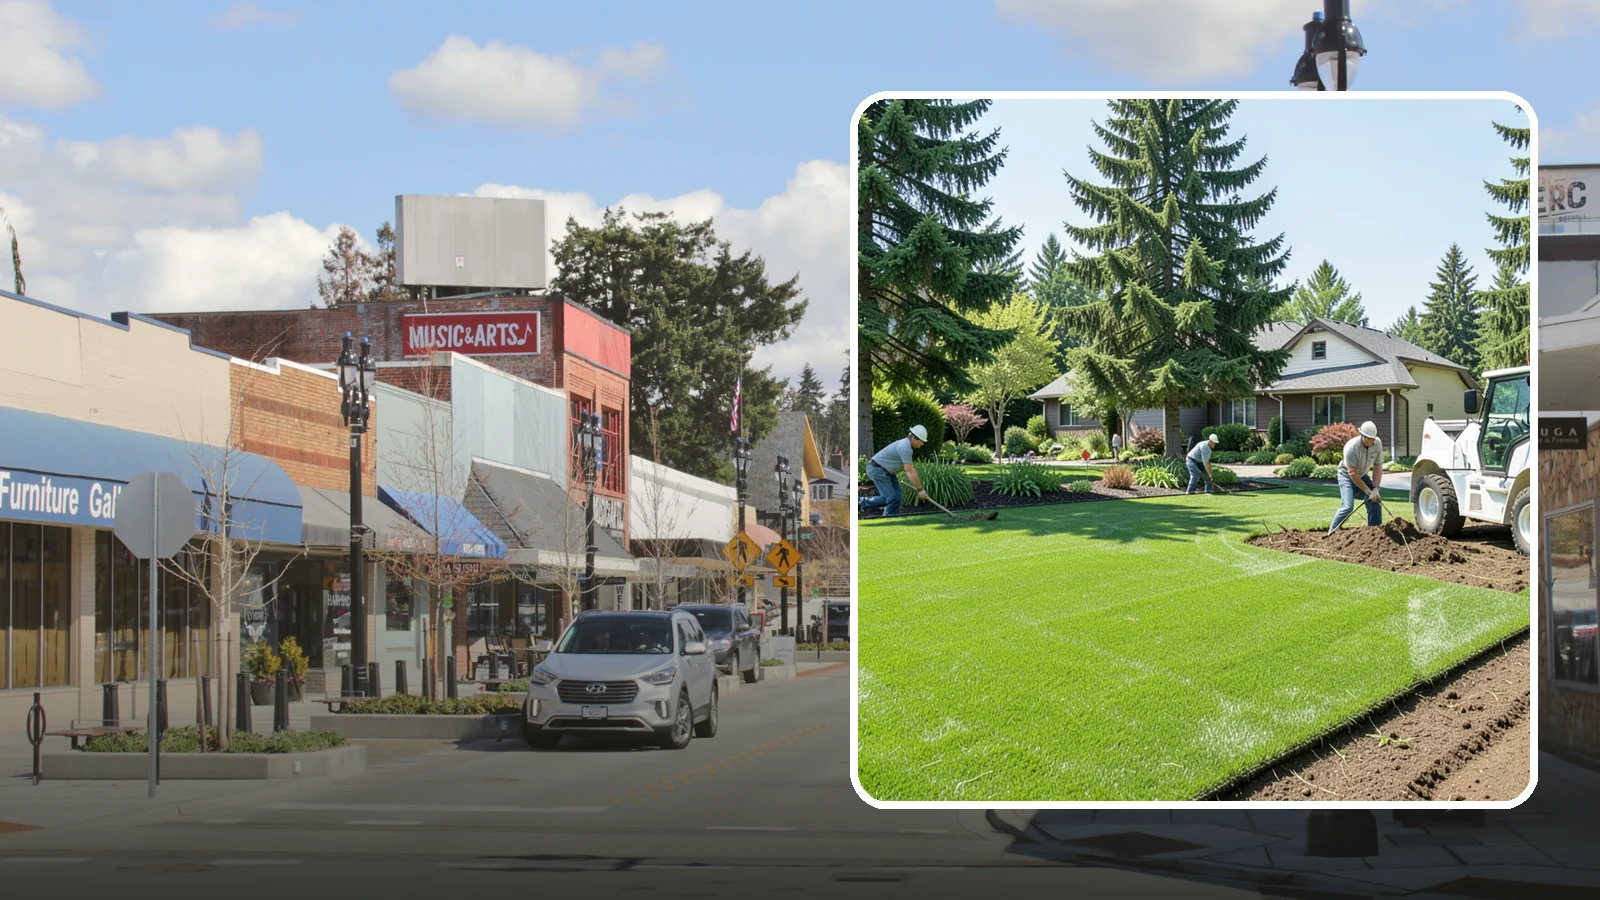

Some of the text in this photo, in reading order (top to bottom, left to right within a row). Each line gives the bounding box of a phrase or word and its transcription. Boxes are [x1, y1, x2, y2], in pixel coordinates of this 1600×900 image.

[1540, 427, 1577, 437] UGA
[0, 471, 79, 515] Furniture
[454, 563, 479, 574] SUSHI
